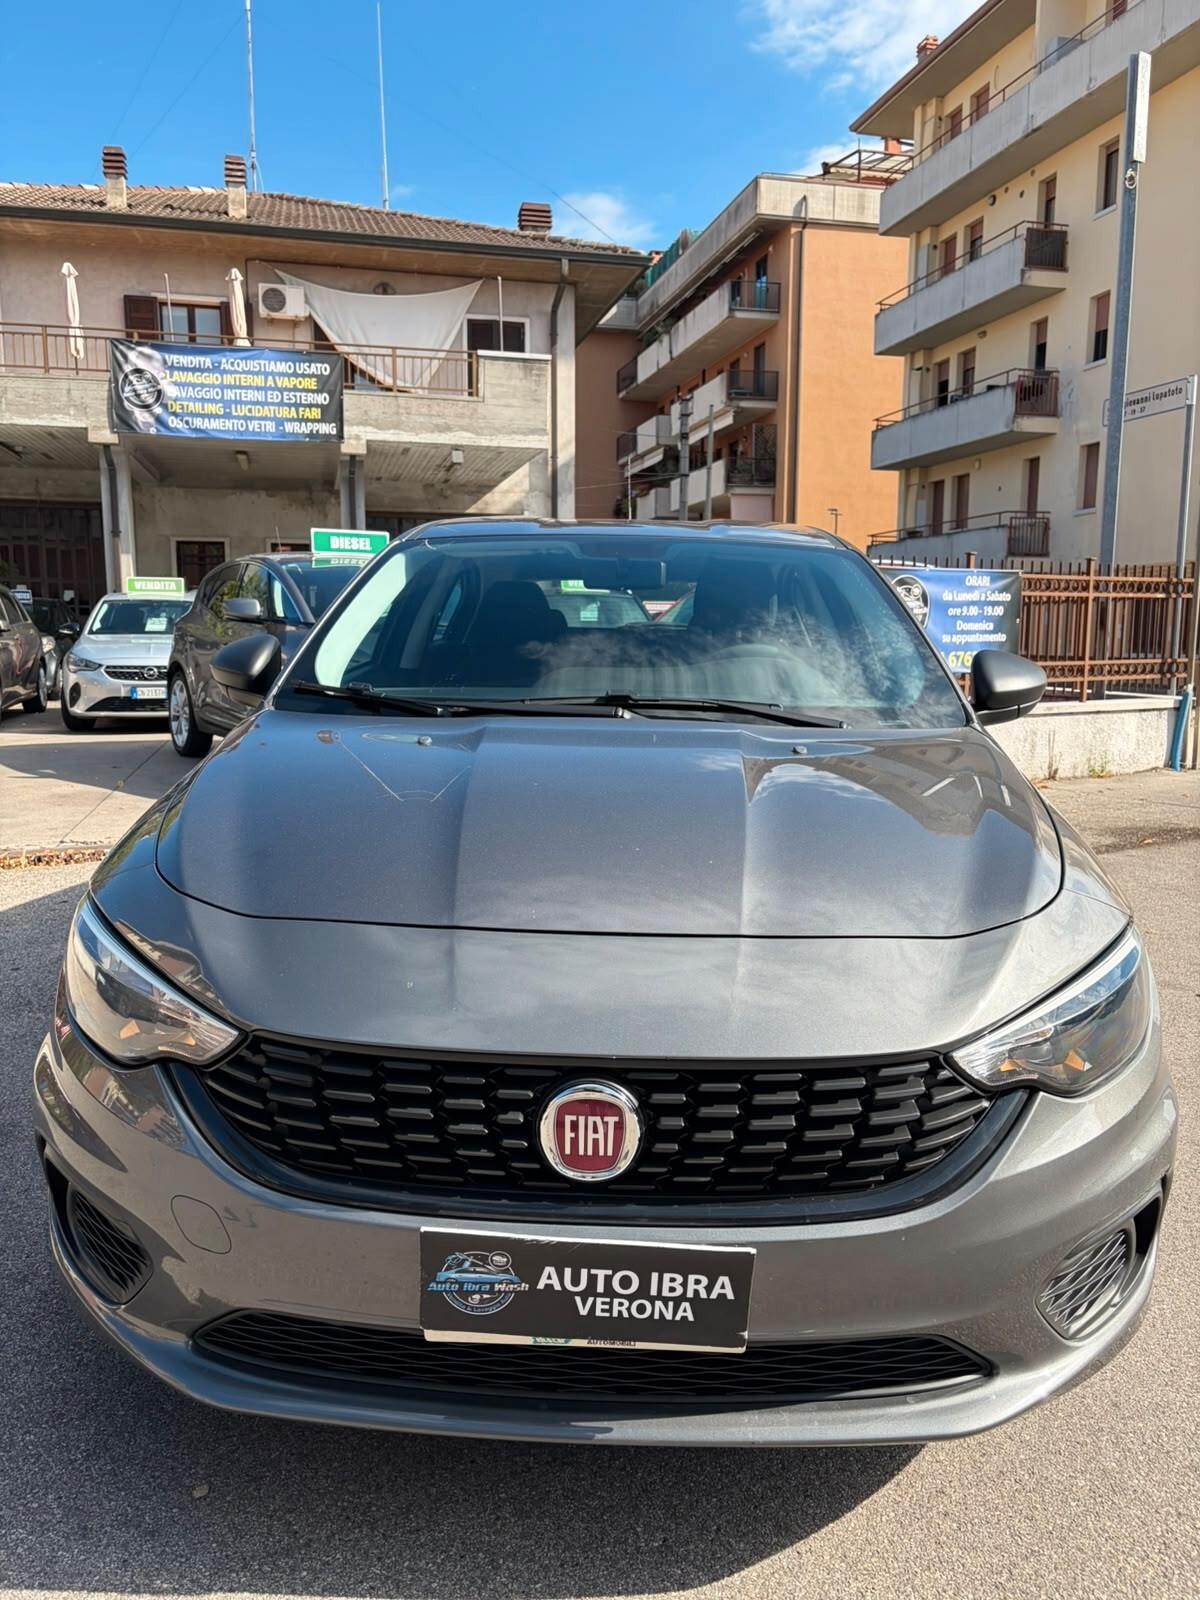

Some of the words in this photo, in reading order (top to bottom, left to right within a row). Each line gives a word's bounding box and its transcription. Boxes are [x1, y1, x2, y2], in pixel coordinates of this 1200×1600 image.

[165, 354, 212, 369] VENDITA
[220, 358, 294, 373] ACQUISTIAMO
[296, 362, 330, 375] USATO
[165, 370, 222, 384] LAVAGGIO
[223, 374, 264, 387] INTERNI
[267, 376, 274, 387] A
[275, 376, 317, 389] VAPORE
[224, 389, 264, 402] INTERNI
[268, 391, 281, 402] ED
[283, 392, 330, 404] ESTERNO
[1124, 392, 1151, 408] iovanni
[1152, 387, 1183, 400] Lupatoto
[168, 400, 224, 415] DETAILING
[232, 404, 297, 418] LUCIDATURA
[299, 408, 321, 419] FARI
[168, 416, 246, 431] OSCURAMENTO
[247, 420, 275, 432] VETRI
[284, 421, 336, 435] WRAPPING
[330, 536, 372, 550] DIESEL
[134, 580, 176, 590] VENDITA
[965, 576, 991, 587] ORARI
[942, 592, 953, 601] da
[986, 591, 1012, 602] Sabato
[948, 608, 962, 616] ore
[962, 606, 978, 616] 9.00
[983, 606, 1004, 616] 19.00
[956, 620, 994, 631] Domenica
[942, 634, 952, 642] su
[952, 633, 1007, 645] appuntamento
[948, 652, 976, 667] 676
[564, 1115, 619, 1156] FIAT
[428, 1282, 460, 1292] Auto
[463, 1282, 490, 1292] Ibra
[494, 1282, 530, 1292] Wash
[536, 1266, 640, 1295] AUTO
[651, 1272, 735, 1300] IBRA
[574, 1296, 694, 1322] VERONA
